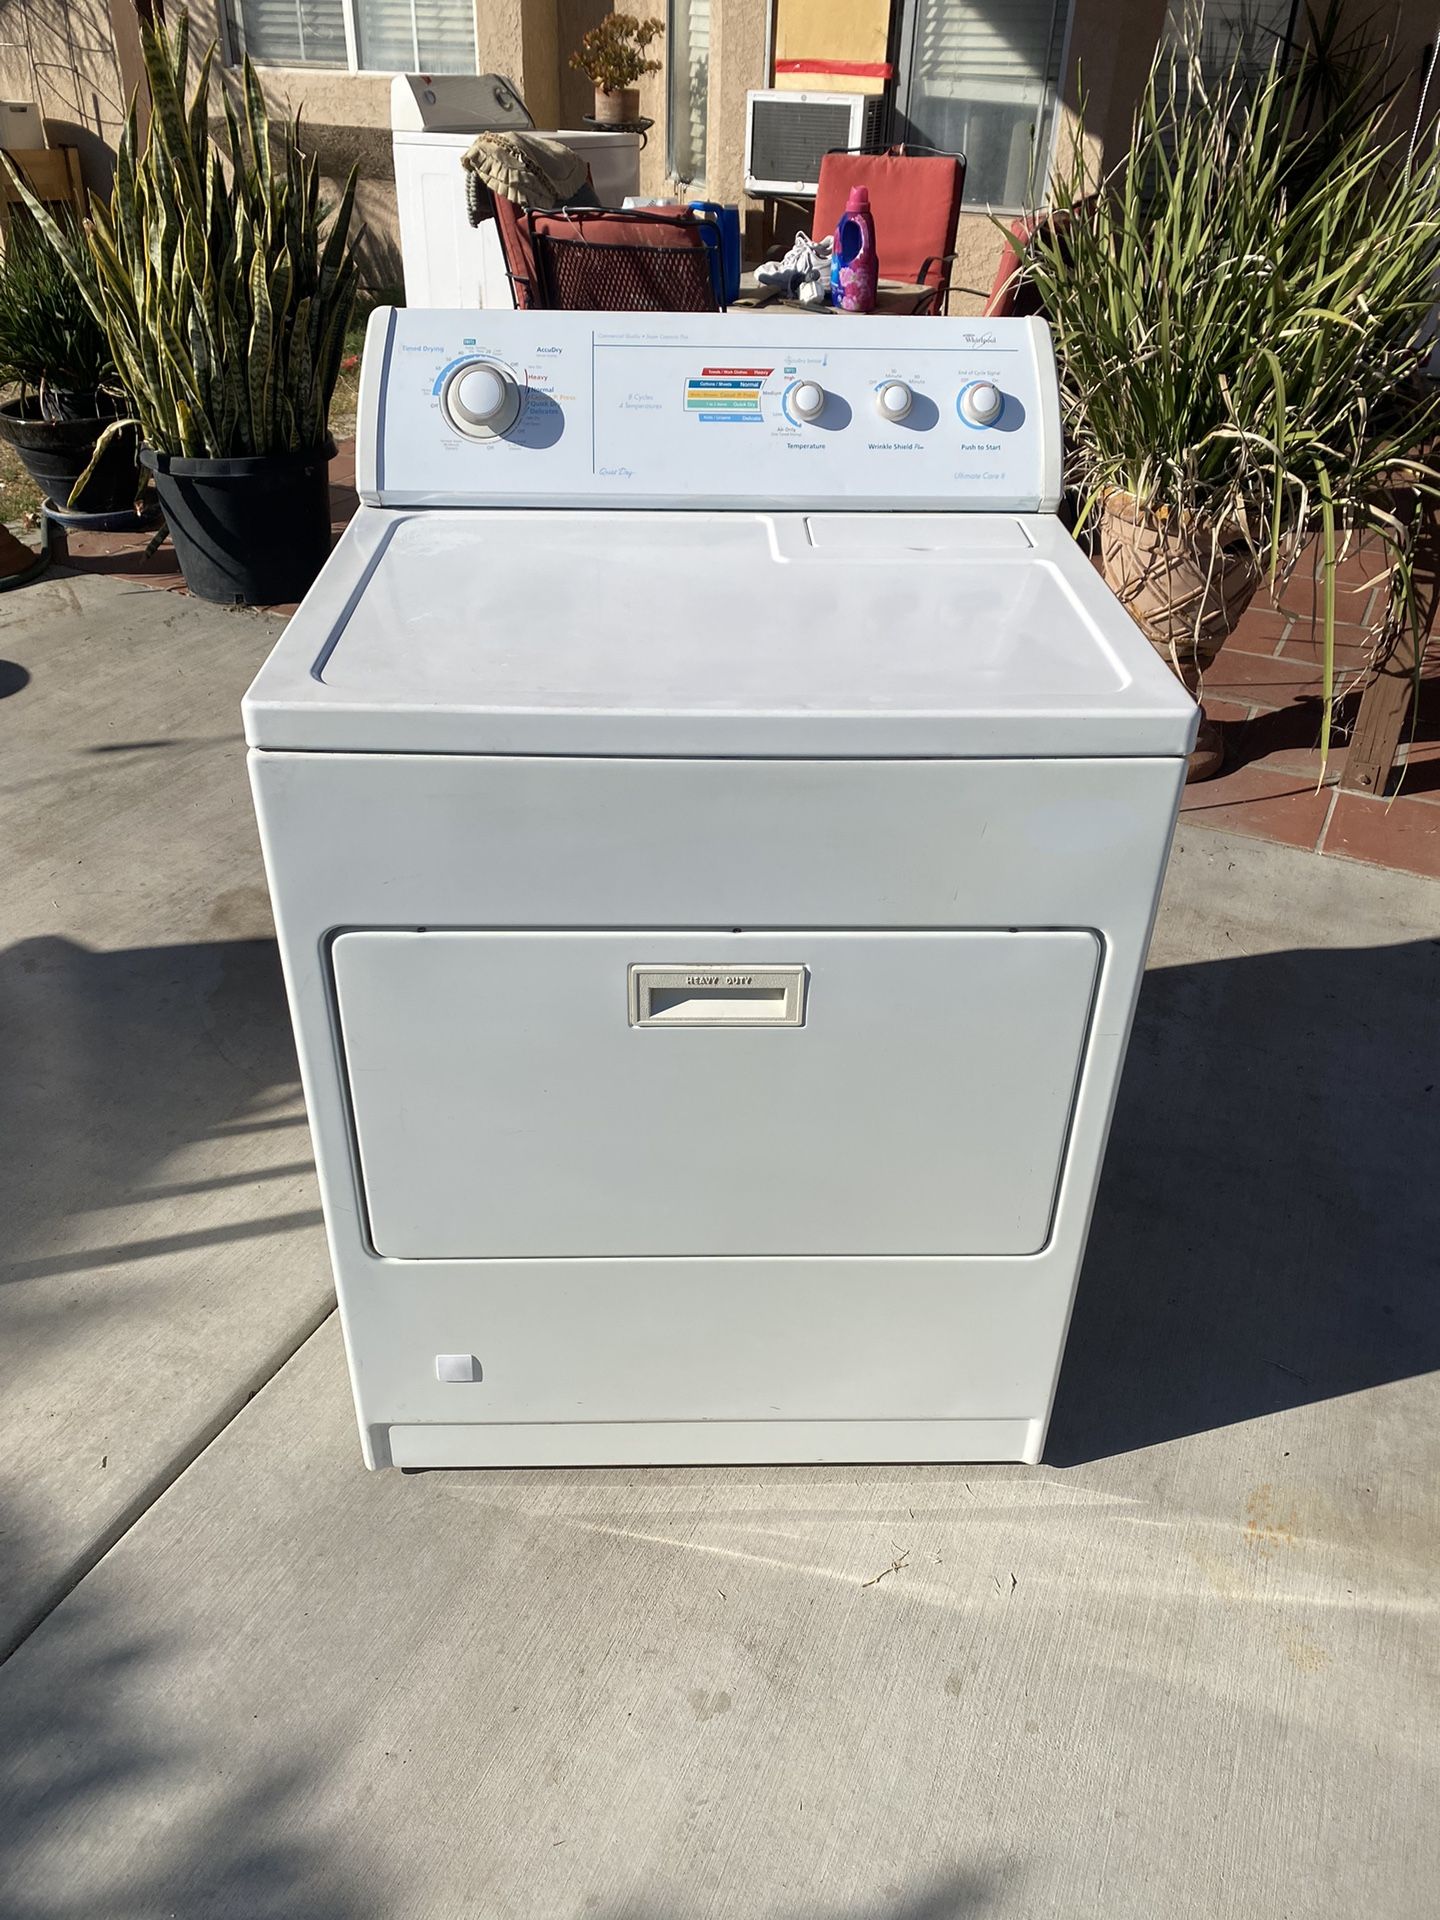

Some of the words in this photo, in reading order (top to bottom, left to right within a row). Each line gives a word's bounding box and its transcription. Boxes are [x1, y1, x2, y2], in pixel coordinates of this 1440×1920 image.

[965, 331, 997, 348] Whirlpool
[422, 345, 445, 353] Drying
[536, 346, 563, 355] AccuDry
[528, 374, 549, 382] Heavy
[634, 393, 654, 402] Cycles
[953, 472, 980, 480] Ultimate
[982, 472, 999, 480] Care
[686, 976, 719, 985] HEAVY
[726, 976, 753, 985] DUTY
